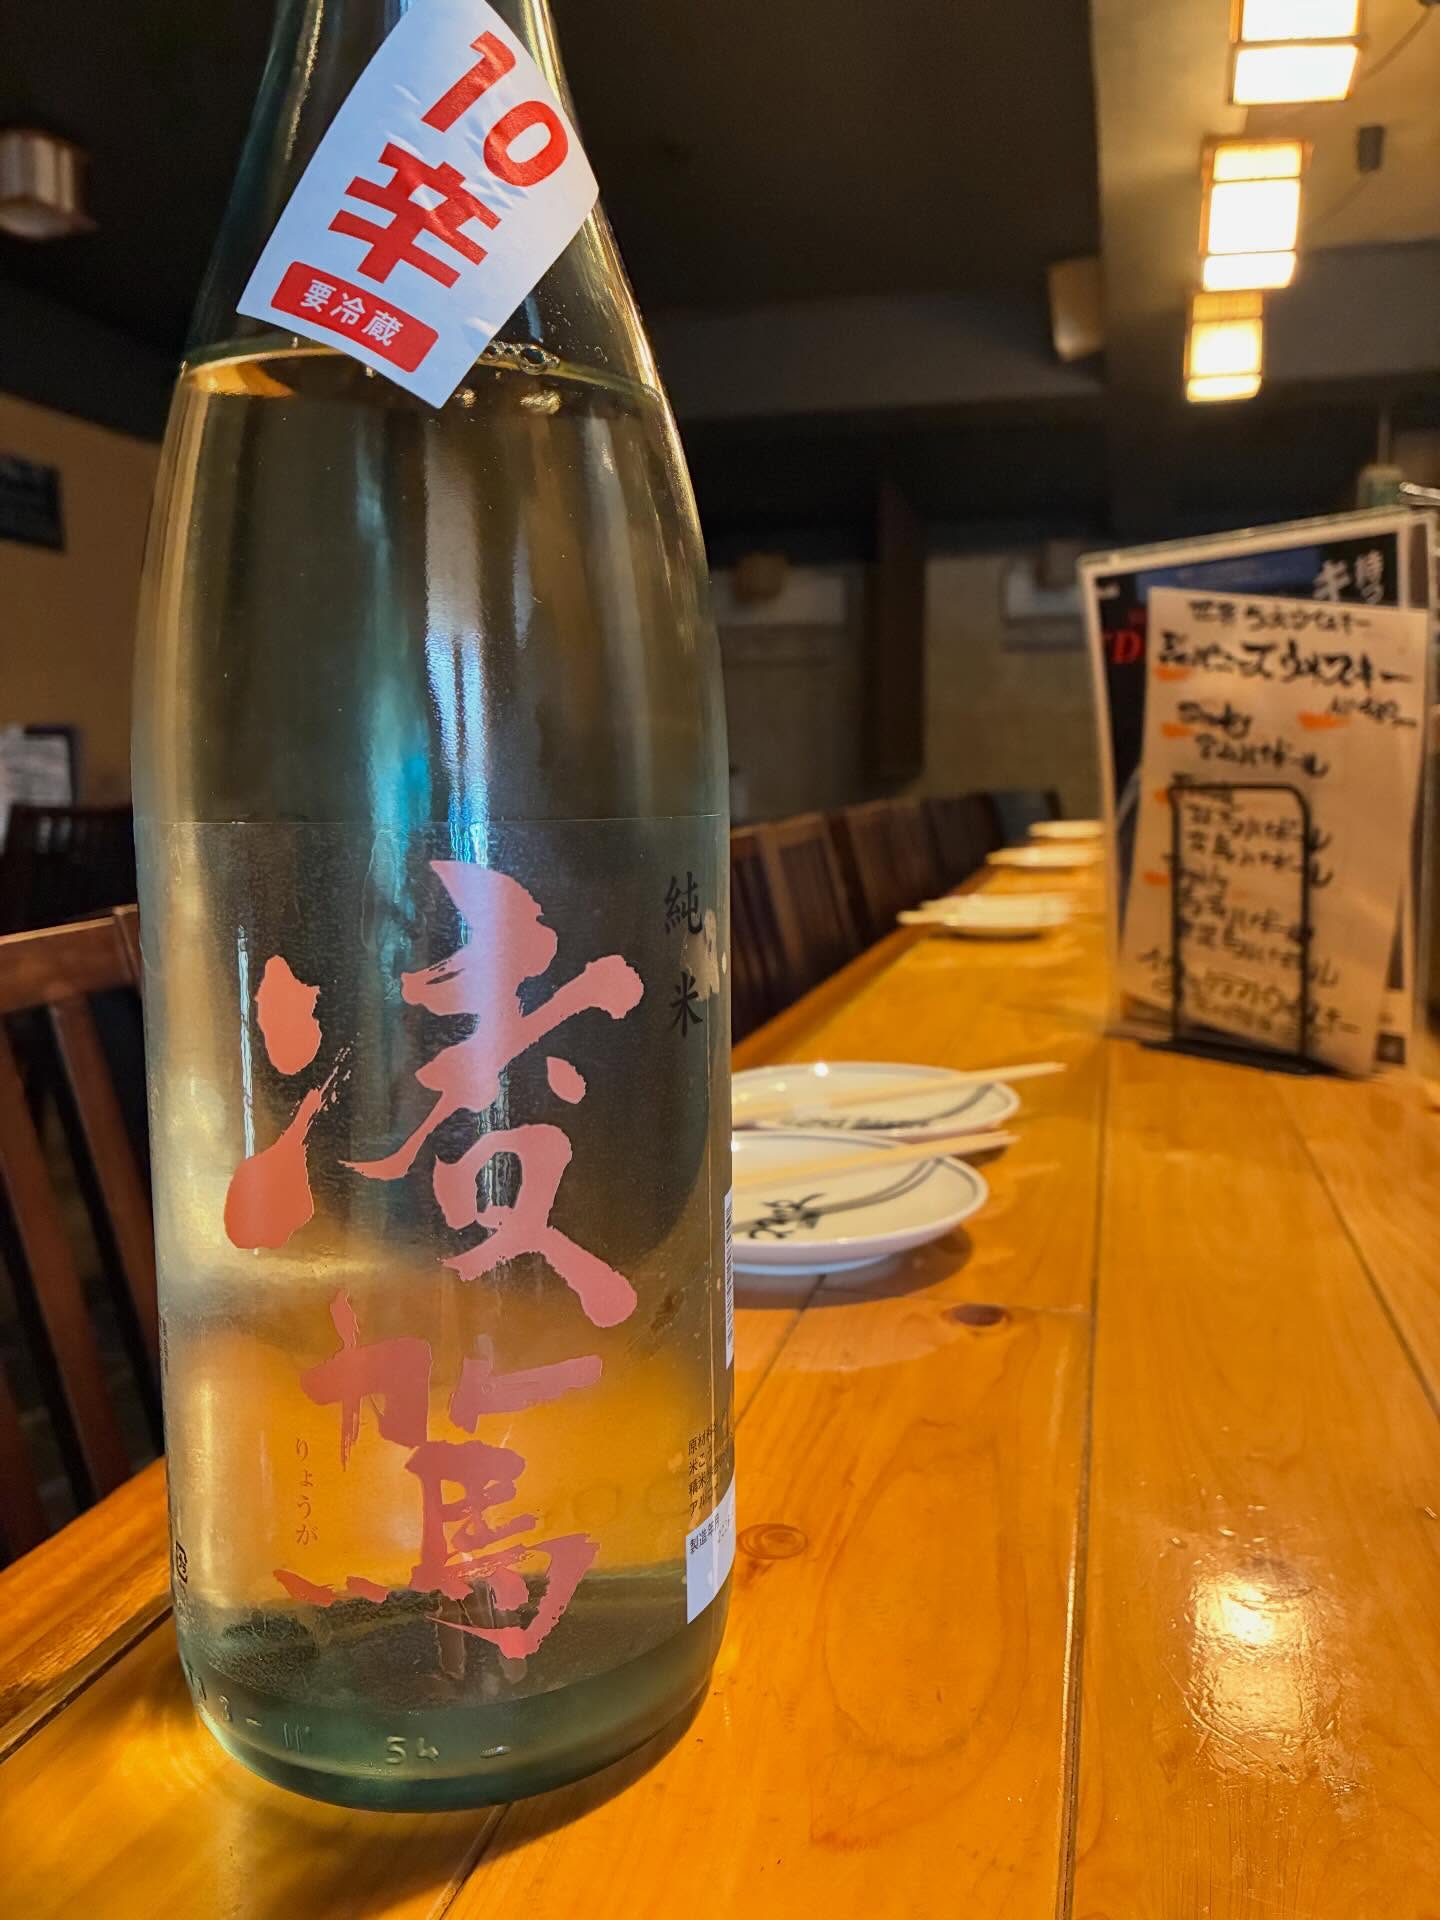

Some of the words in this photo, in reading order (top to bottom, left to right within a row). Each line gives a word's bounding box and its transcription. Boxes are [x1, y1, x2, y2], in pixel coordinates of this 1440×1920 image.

[421, 30, 568, 187] 10
[328, 142, 501, 288] 辛
[299, 278, 404, 347] 要冷蔵
[664, 871, 703, 1038] 純米
[296, 1438, 318, 1546] りょうが
